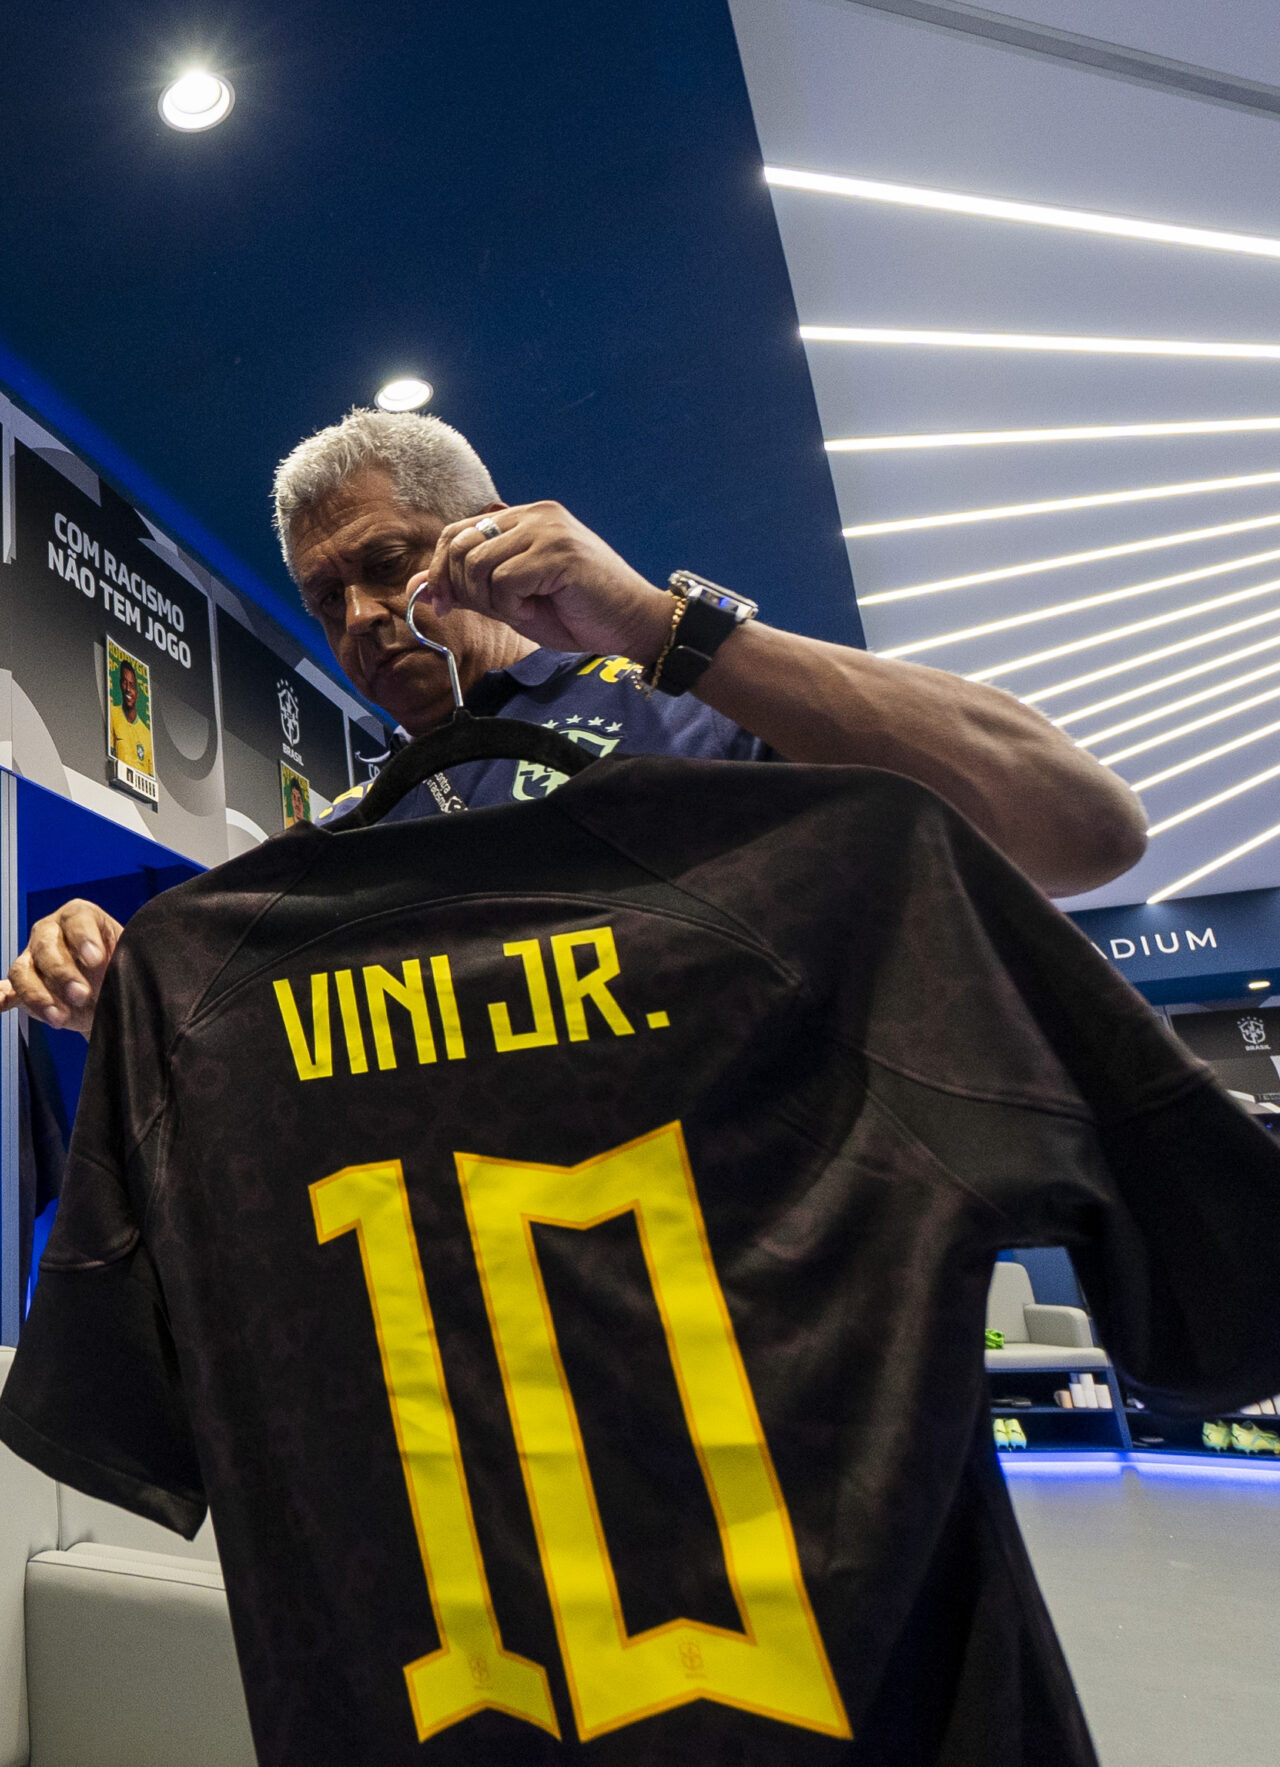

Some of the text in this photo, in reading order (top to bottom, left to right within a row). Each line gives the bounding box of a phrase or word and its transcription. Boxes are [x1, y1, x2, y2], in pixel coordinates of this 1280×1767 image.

[48, 541, 192, 669] NÃO TEM JOGO
[54, 512, 185, 633] COM RACISMO
[282, 743, 304, 767] BRASIL
[273, 926, 670, 1081] VINI JR.
[1091, 927, 1217, 960] DIUM
[308, 1119, 853, 1744] 10
